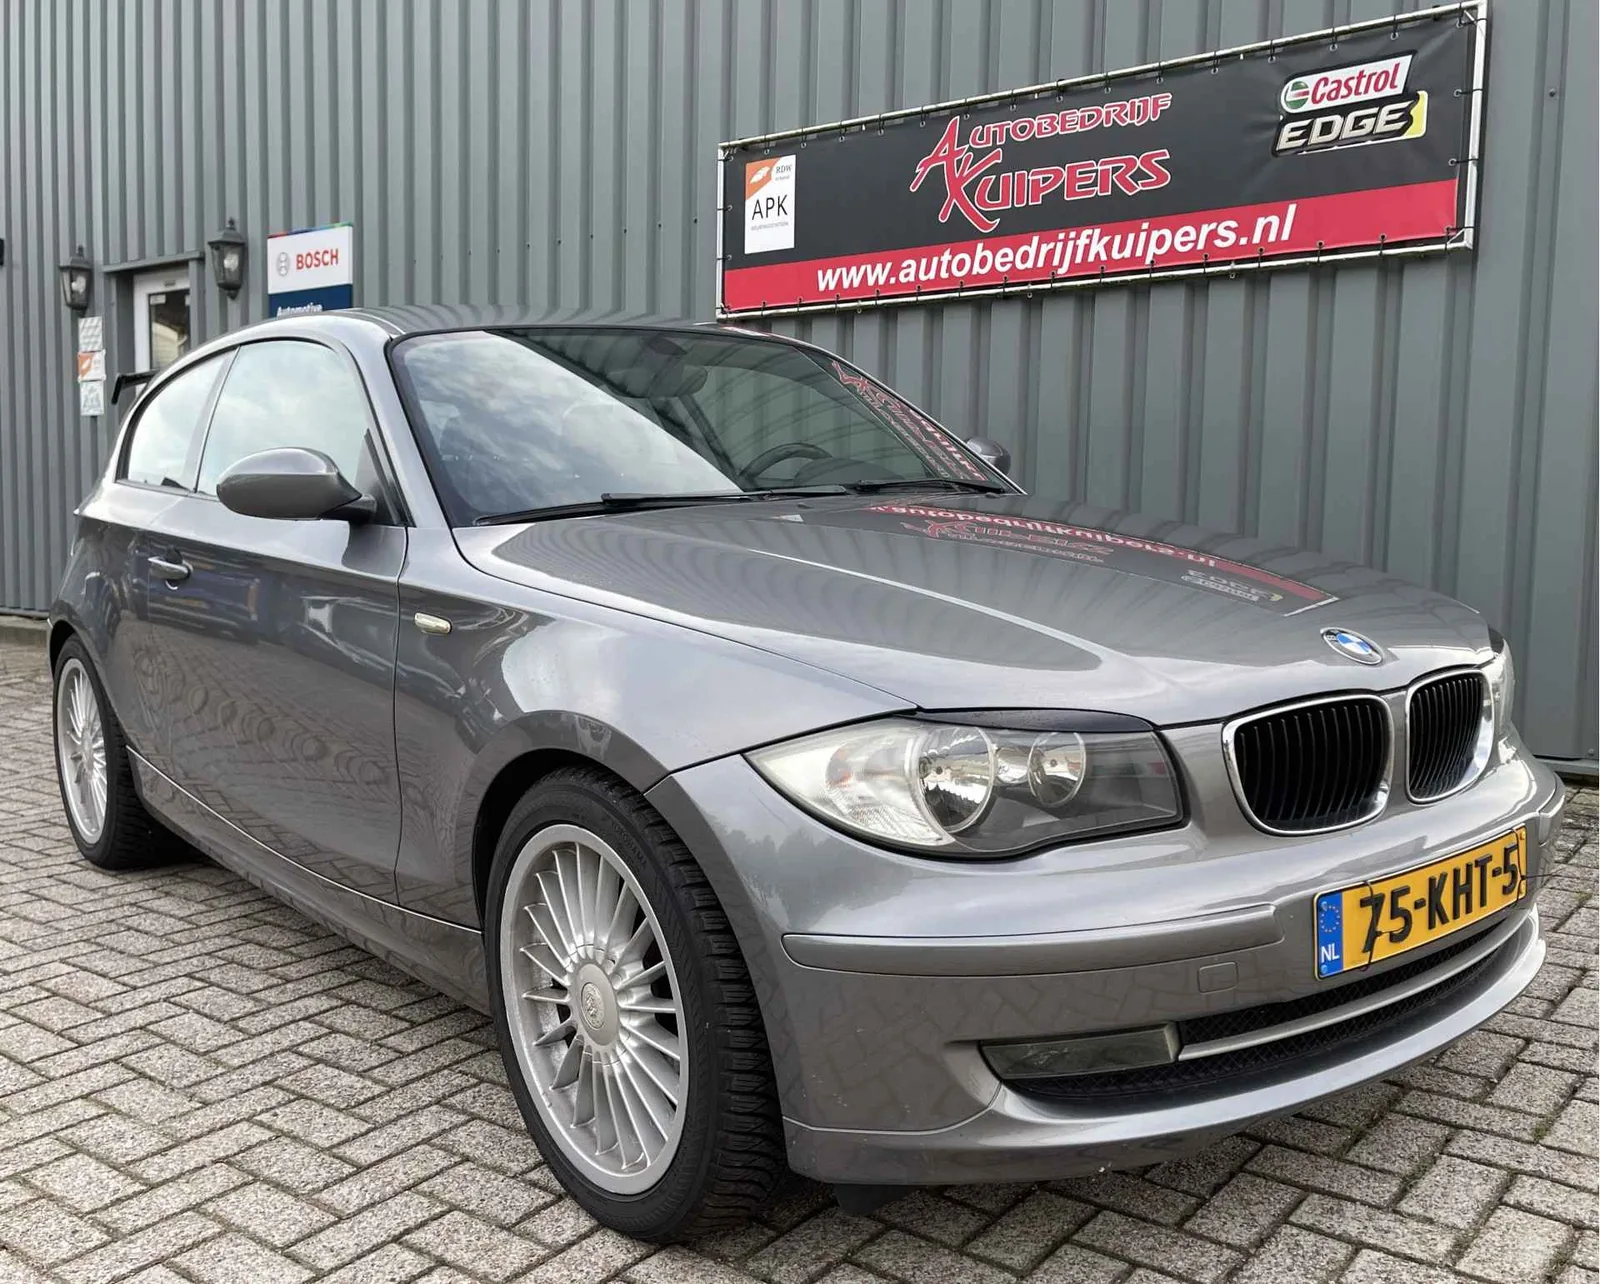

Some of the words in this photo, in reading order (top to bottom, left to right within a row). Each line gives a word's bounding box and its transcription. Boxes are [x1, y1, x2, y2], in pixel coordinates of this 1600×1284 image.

[1311, 62, 1401, 105] Castrol
[1276, 100, 1415, 151] EDGE
[775, 164, 793, 174] RDW
[752, 194, 788, 221] APK
[295, 248, 339, 270] BOSCH
[816, 204, 1298, 292] www.autobedrijfkuipers.nl
[1359, 843, 1519, 954] 75-KHT-5
[1320, 942, 1341, 963] NL
